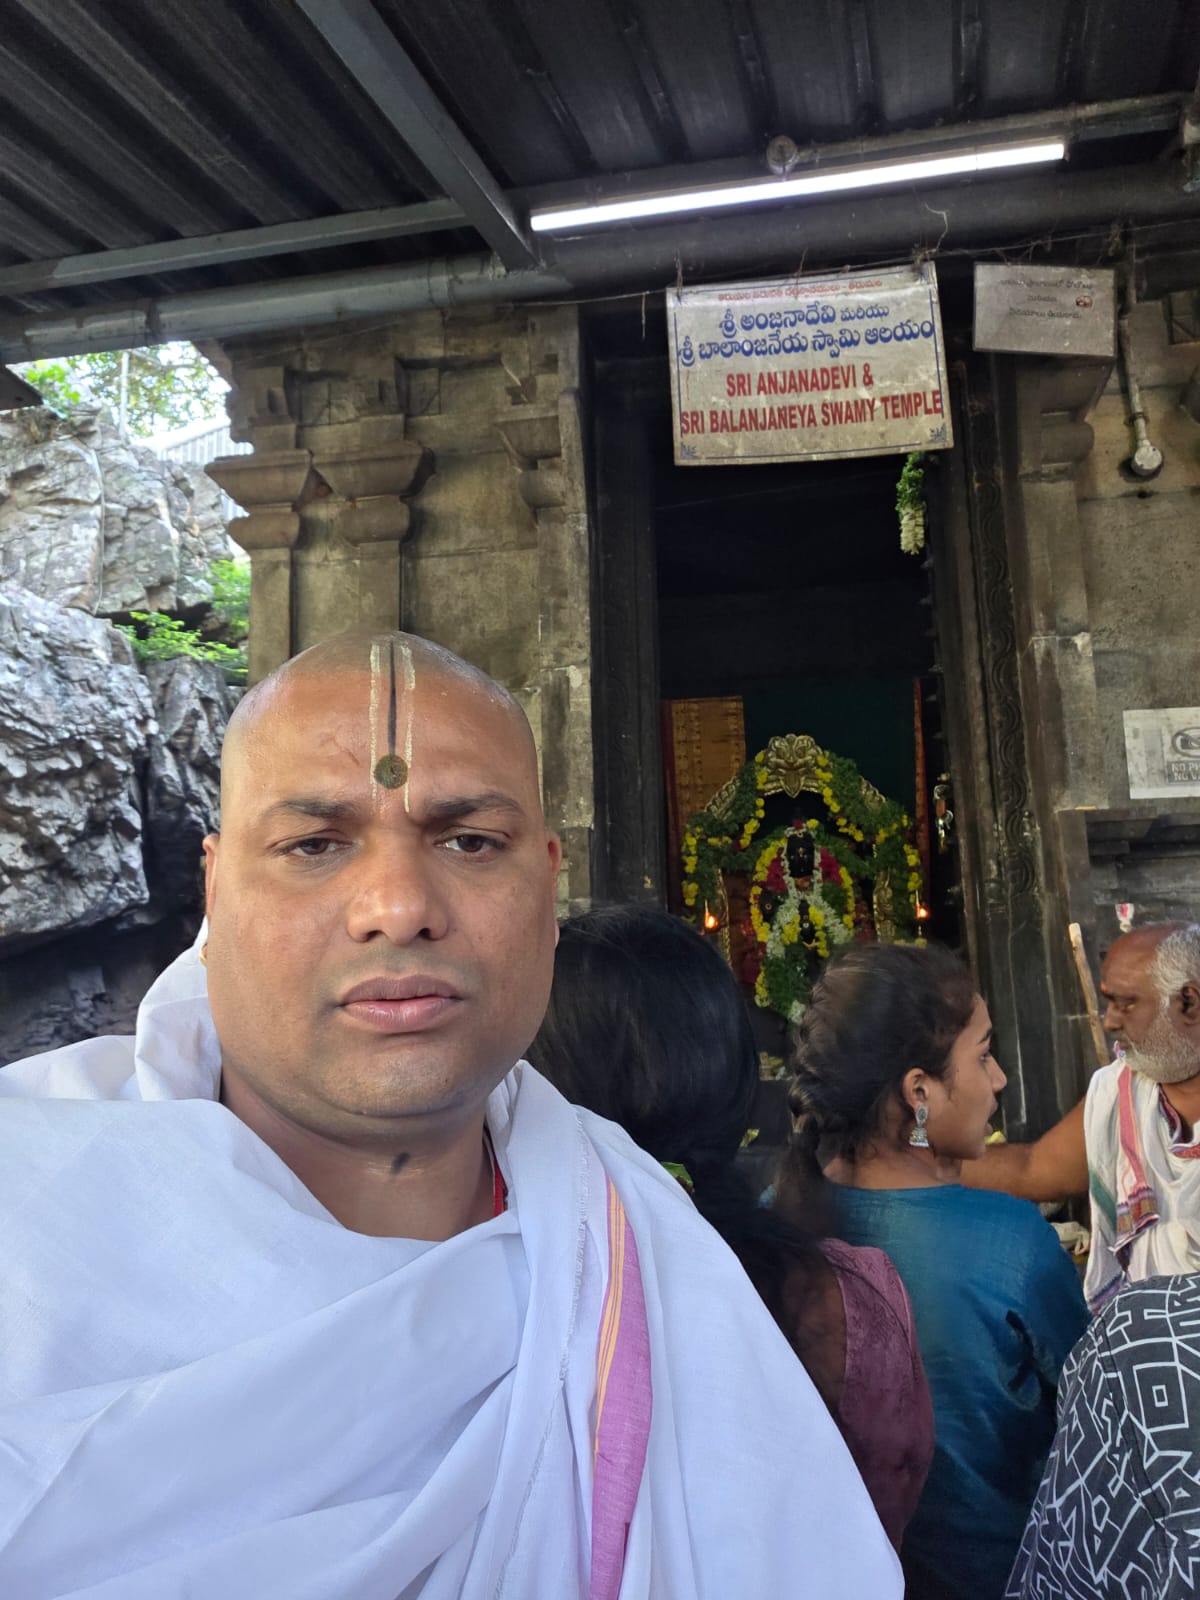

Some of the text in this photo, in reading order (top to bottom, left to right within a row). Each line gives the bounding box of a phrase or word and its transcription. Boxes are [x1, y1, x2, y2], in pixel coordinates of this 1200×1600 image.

[719, 301, 890, 339] శ్రీ అంజనాదేవి మరియు
[678, 318, 935, 367] శ్రీ బాలాంజనేయ స్వామి ఆలయం
[726, 362, 874, 398] SRI ANJANADEVI &
[680, 389, 942, 435] SRI BALANJANEYA SWAMY TEMPLE
